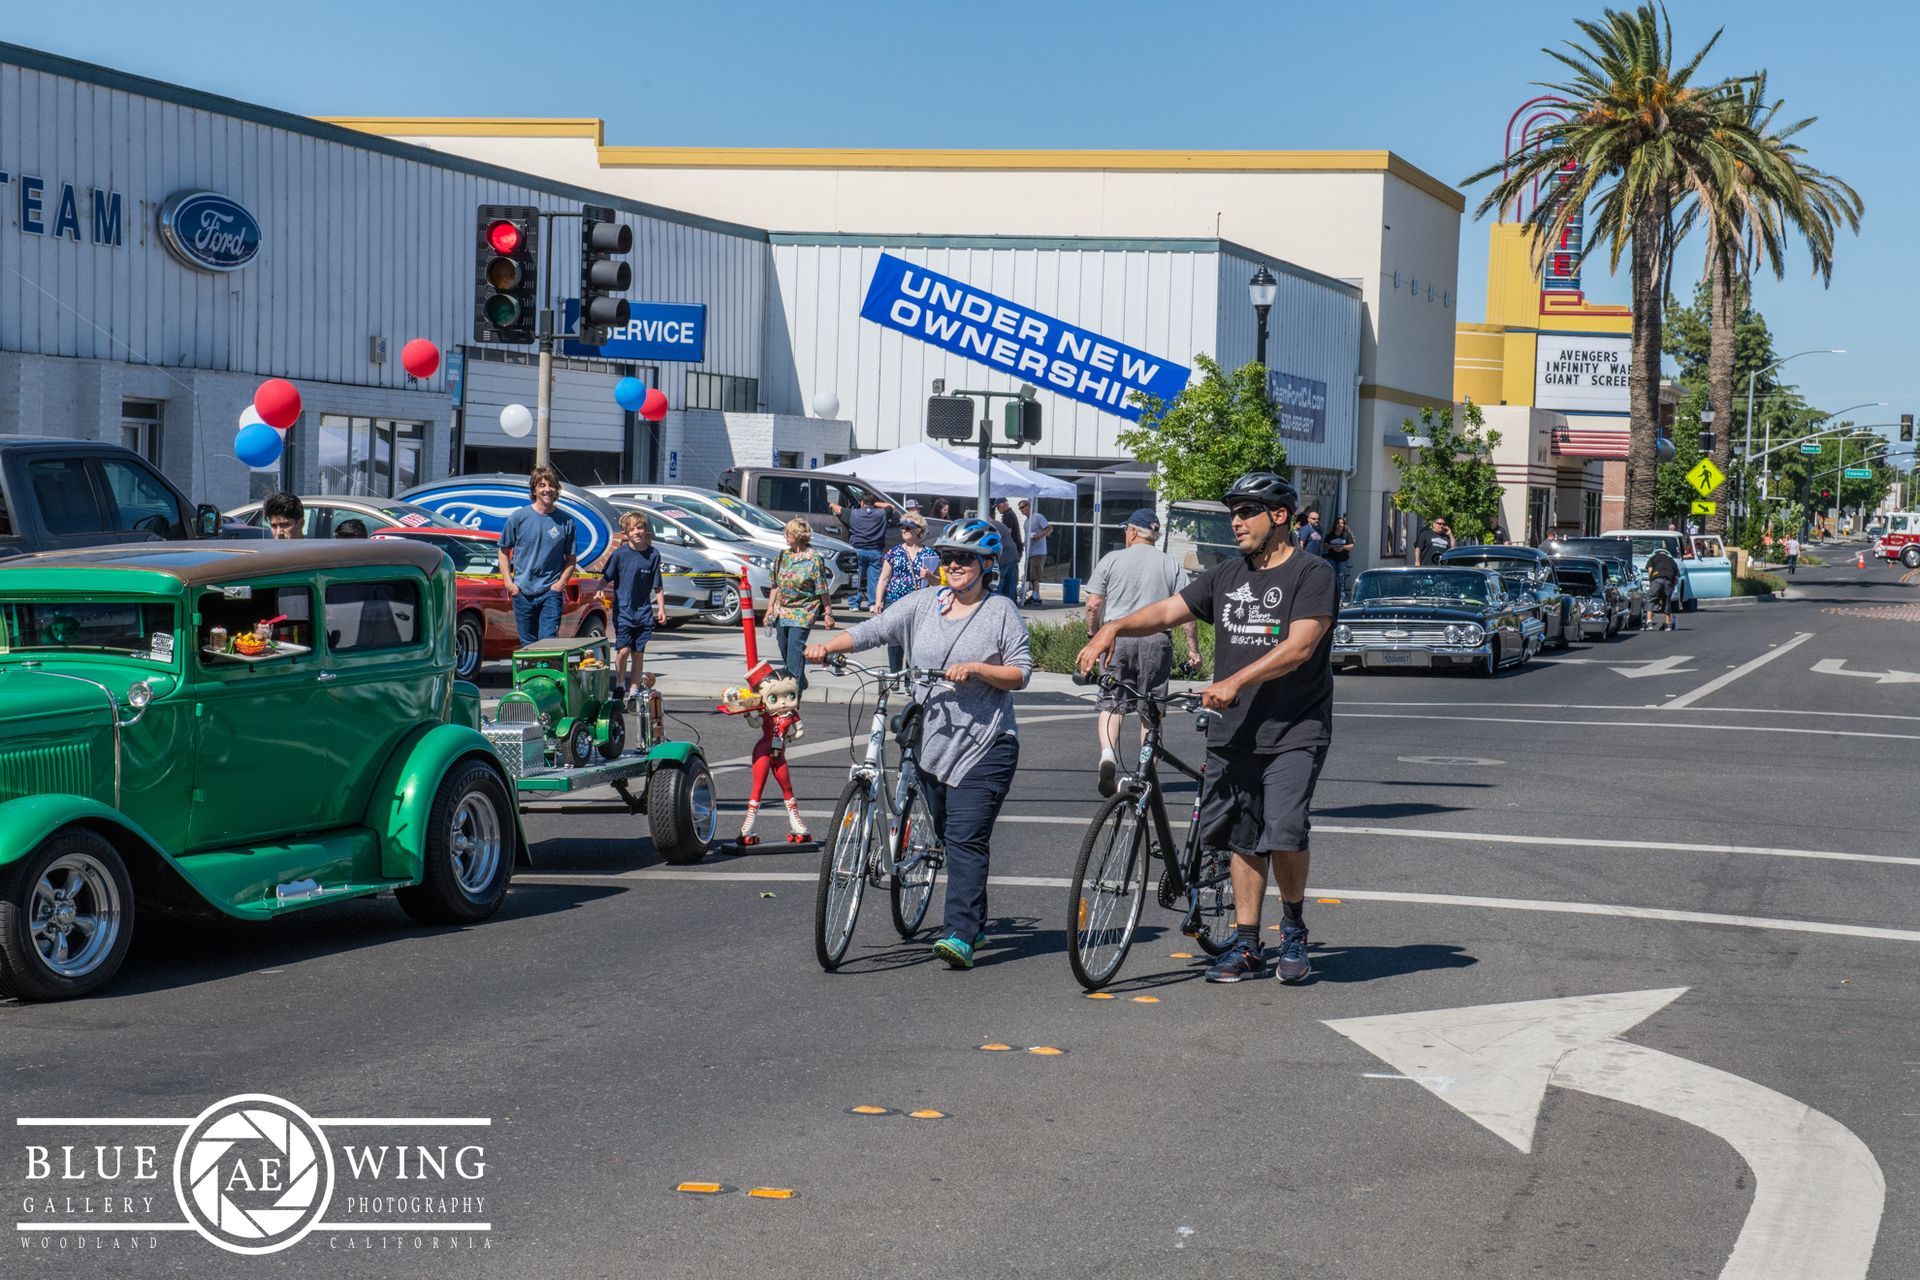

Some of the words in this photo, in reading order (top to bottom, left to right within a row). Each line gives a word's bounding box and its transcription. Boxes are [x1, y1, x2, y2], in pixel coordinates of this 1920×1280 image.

[0, 171, 122, 247] EAM
[195, 209, 246, 256] Ford
[900, 270, 1049, 346] UNDER
[1056, 330, 1160, 386] NEW
[1546, 361, 1599, 373] INFINITY
[1560, 350, 1618, 362] AVENGERS
[1545, 373, 1580, 385] GIANT
[1592, 375, 1633, 386] SCREE
